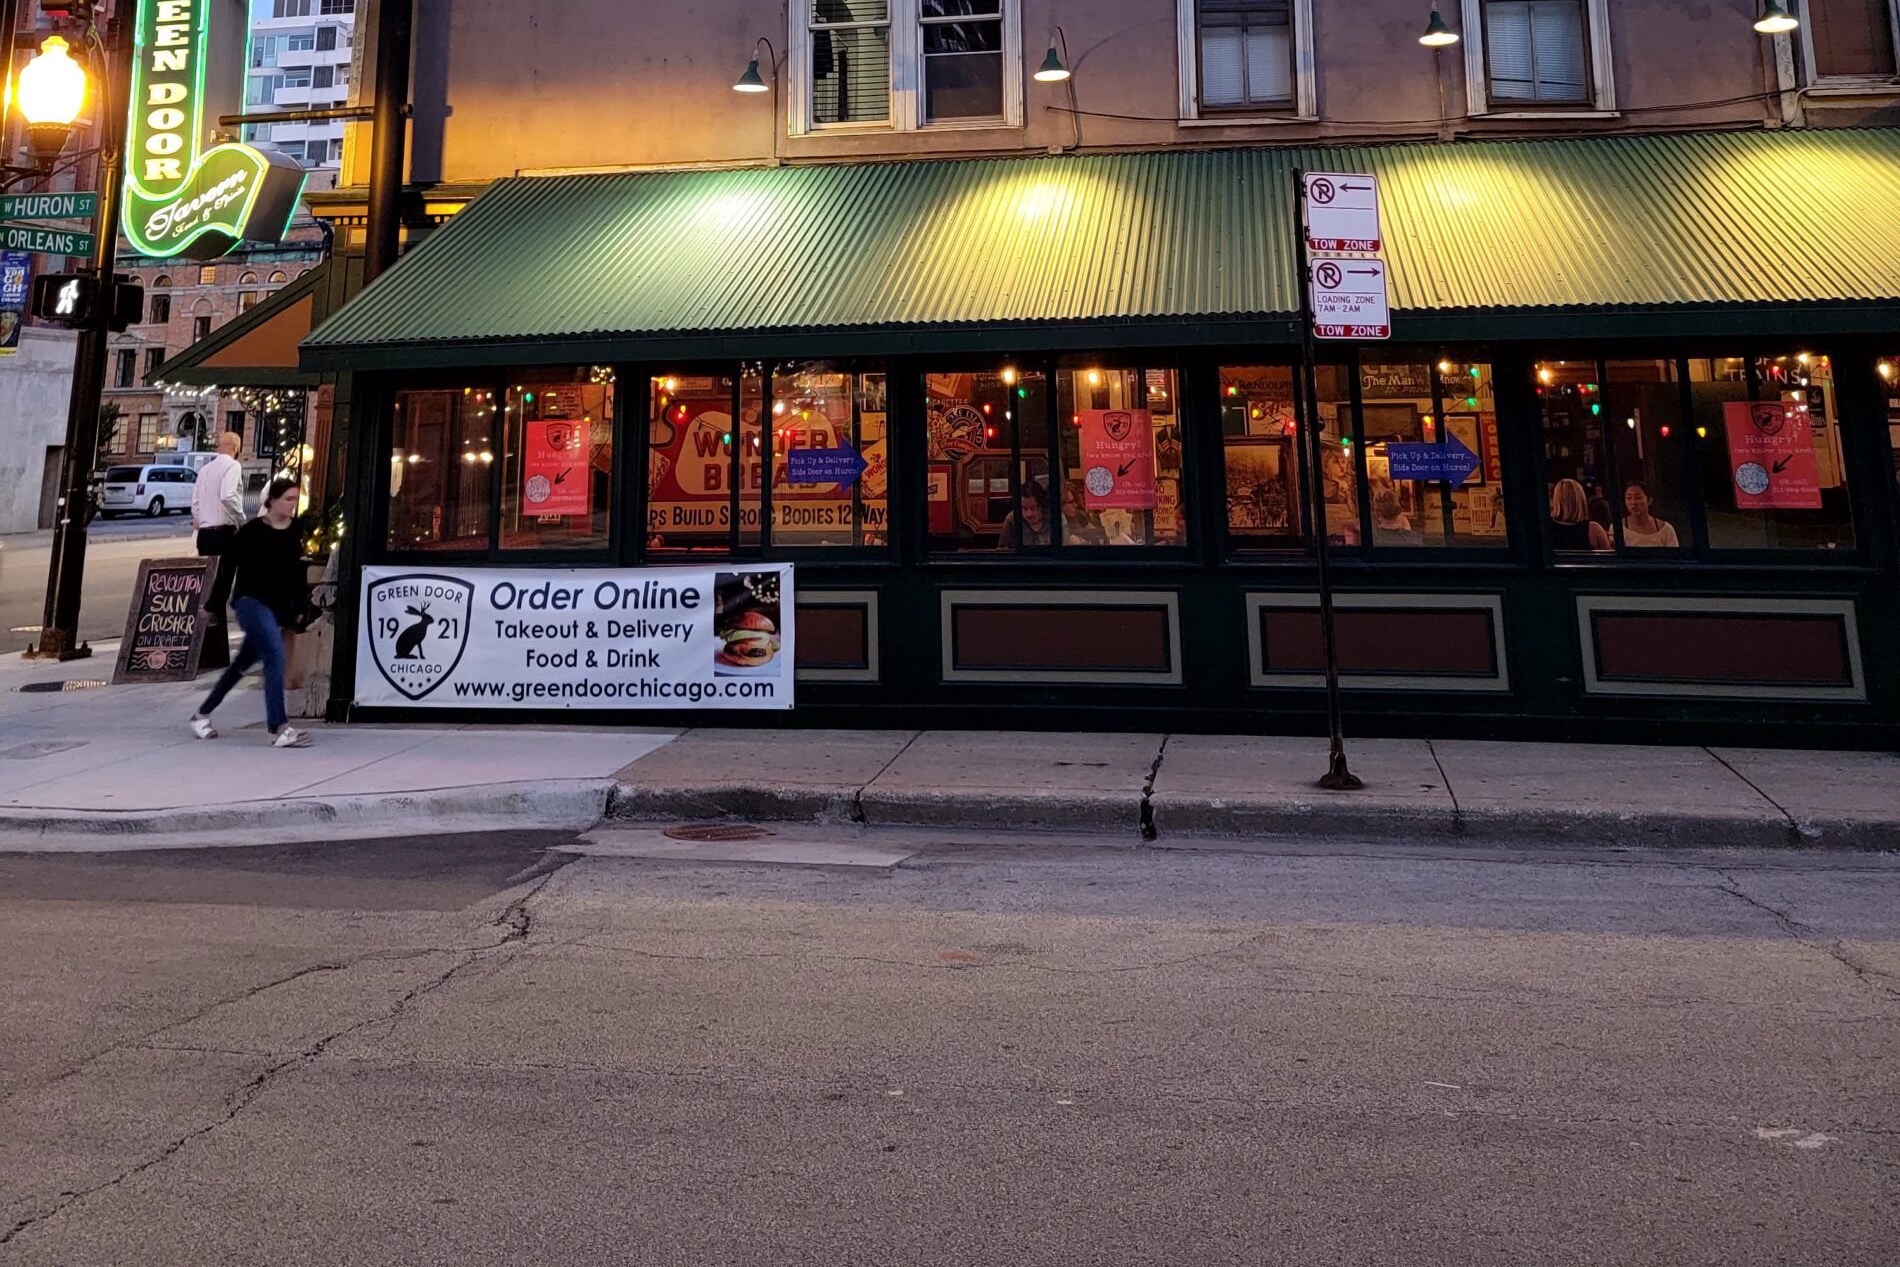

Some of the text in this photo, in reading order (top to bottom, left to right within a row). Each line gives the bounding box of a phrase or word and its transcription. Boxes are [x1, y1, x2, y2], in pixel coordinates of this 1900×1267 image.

[143, 82, 188, 181] DOOR
[4, 196, 91, 216] W HURON ST
[144, 169, 248, 242] Tavern
[8, 229, 74, 253] ORLEANS
[79, 240, 89, 251] ST
[1313, 239, 1374, 250] TOW ZONE
[1317, 295, 1376, 304] LOADING ZONE
[1319, 325, 1383, 336] TOW ZONE
[1363, 375, 1386, 390] The
[1388, 375, 1415, 385] Man
[1095, 440, 1141, 451] Hungry?
[1744, 433, 1799, 446] Hungry?
[807, 457, 817, 465] Up
[1391, 452, 1408, 460] Pick
[1410, 452, 1421, 461] Up
[791, 468, 806, 476] Side
[673, 506, 715, 526] BUILD
[782, 505, 834, 526] BODIES
[837, 505, 852, 525] 12
[148, 573, 205, 595] REVOLUTION
[150, 594, 189, 613] SUN
[377, 585, 463, 604] GREEN DOOR
[490, 580, 700, 610] Order Online
[138, 613, 195, 635] CRUSHER
[379, 617, 458, 639] 19 21
[495, 619, 694, 643] Takeout & Delivery
[137, 635, 189, 646] ON DRAFT
[526, 648, 661, 668] Food & Drink
[390, 664, 442, 674] CHICAGO
[454, 677, 775, 703] www.greendoorchicago.com
